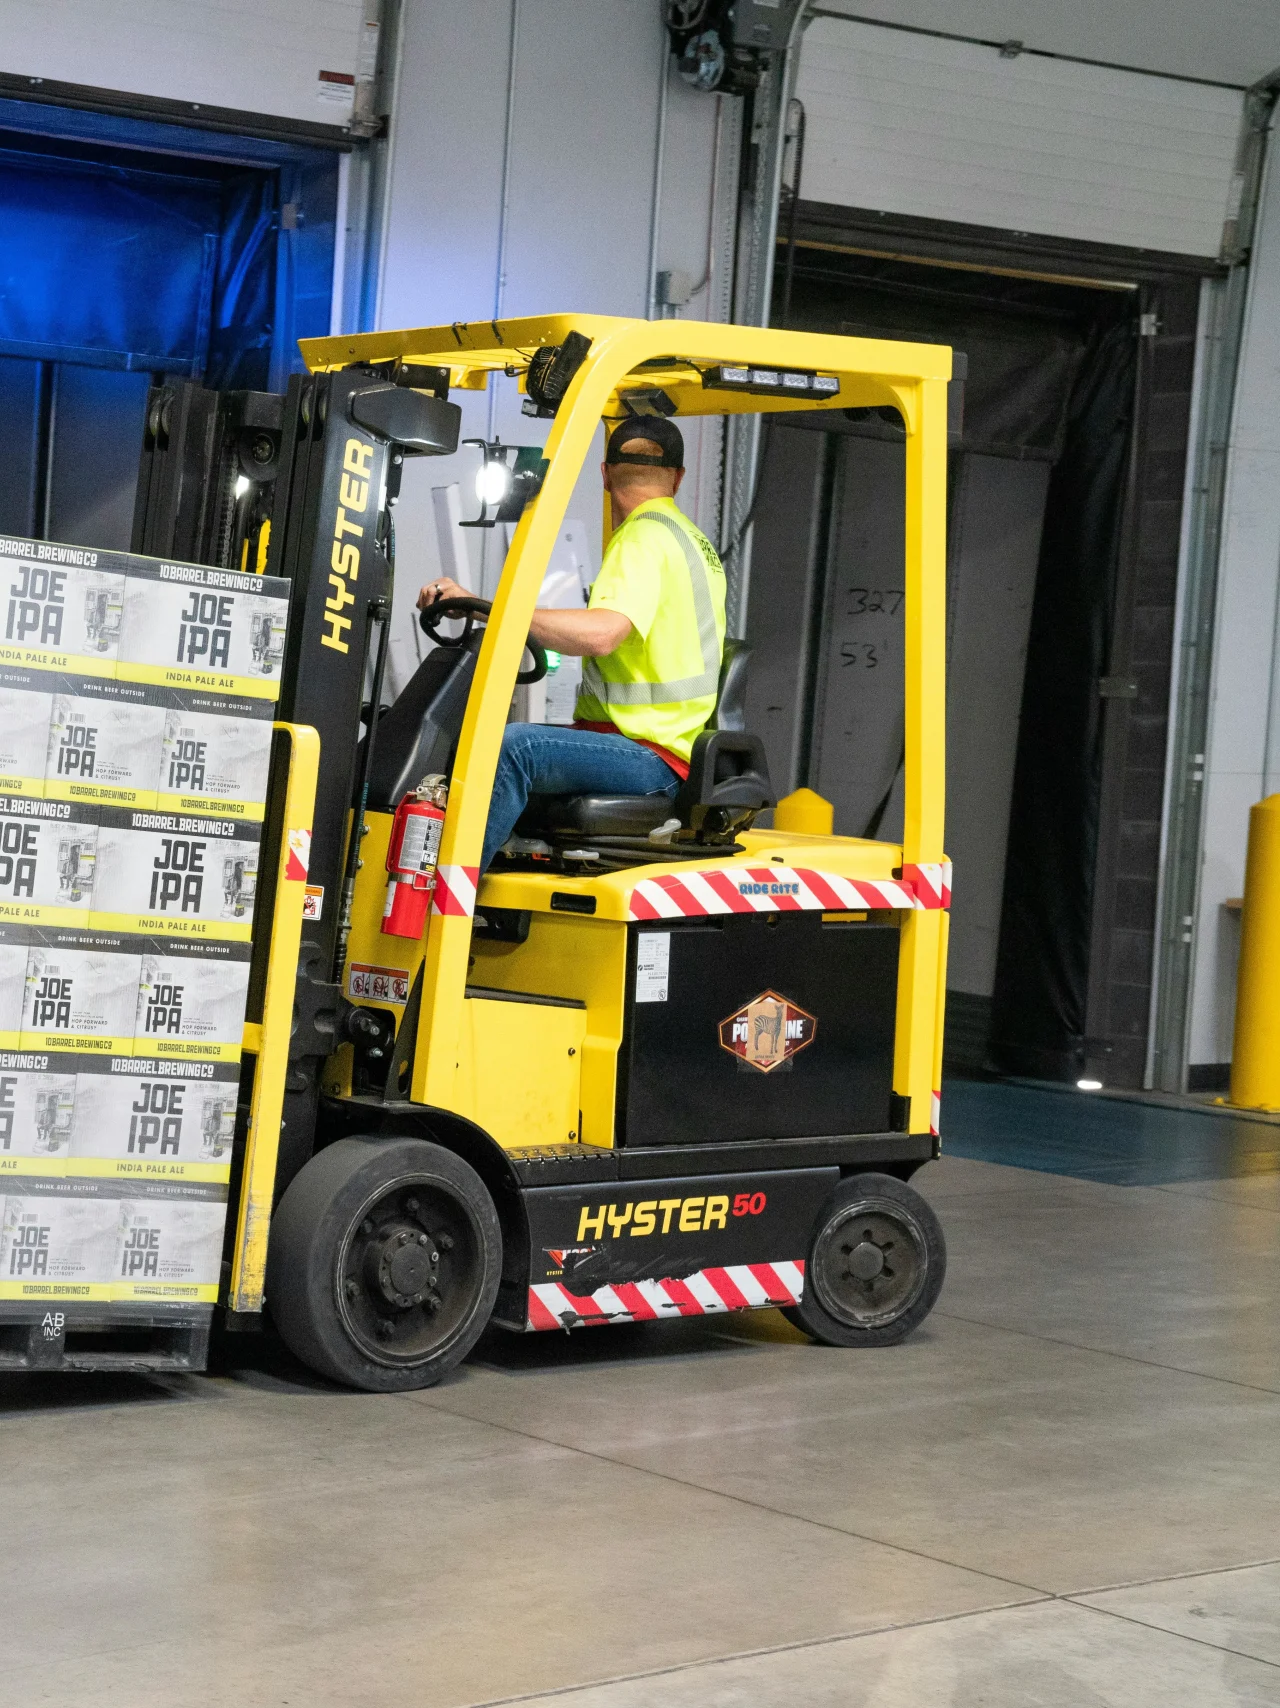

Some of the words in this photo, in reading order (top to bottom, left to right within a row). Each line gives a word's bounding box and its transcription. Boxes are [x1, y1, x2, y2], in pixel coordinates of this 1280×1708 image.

[321, 438, 374, 654] HYSTER
[10, 565, 67, 603] JOE
[181, 591, 235, 627] JOE
[847, 588, 905, 615] 327
[5, 599, 64, 645] IPA
[176, 624, 231, 668] IPA
[26, 654, 47, 664] PALE
[50, 657, 68, 666] ALE
[4, 674, 31, 683] OUTSIDE
[83, 683, 103, 692] DRINK
[120, 689, 146, 698] OUTSIDE
[166, 672, 192, 683] INDIA
[195, 676, 215, 686] PALE
[218, 679, 234, 688] ALE
[192, 698, 211, 707] DRINK
[228, 703, 253, 712] OUTSIDE
[60, 724, 98, 749] JOE
[57, 747, 96, 777] IPA
[171, 739, 207, 763] JOE
[168, 761, 205, 791] IPA
[153, 838, 207, 872] JOE
[149, 871, 203, 913] IPA
[739, 883, 769, 895] RIDE
[771, 883, 799, 894] RITE
[0, 907, 20, 916] PALE
[23, 909, 41, 918] ALE
[138, 919, 164, 929] INDIA
[168, 922, 188, 931] PALE
[191, 924, 207, 932] ALE
[57, 935, 77, 943] DRINK
[95, 938, 121, 946] OUTSIDE
[205, 946, 230, 954] OUTSIDE
[35, 977, 73, 1000] JOE
[148, 984, 184, 1007] JOE
[32, 1000, 71, 1028] IPA
[145, 1006, 182, 1034] IPA
[132, 1082, 186, 1115] JOE
[127, 1115, 182, 1155] IPA
[1, 1161, 18, 1169] ALE
[116, 1163, 142, 1173] INDIA
[146, 1166, 166, 1174] PALE
[169, 1166, 185, 1174] ALE
[576, 1195, 730, 1242] HYSTER
[732, 1191, 767, 1217] 50
[13, 1226, 51, 1247] JOE
[124, 1228, 161, 1249] JOE
[10, 1248, 48, 1275] IPA
[121, 1250, 159, 1276] IPA
[41, 1312, 65, 1327] A-B
[43, 1326, 61, 1337] INC
